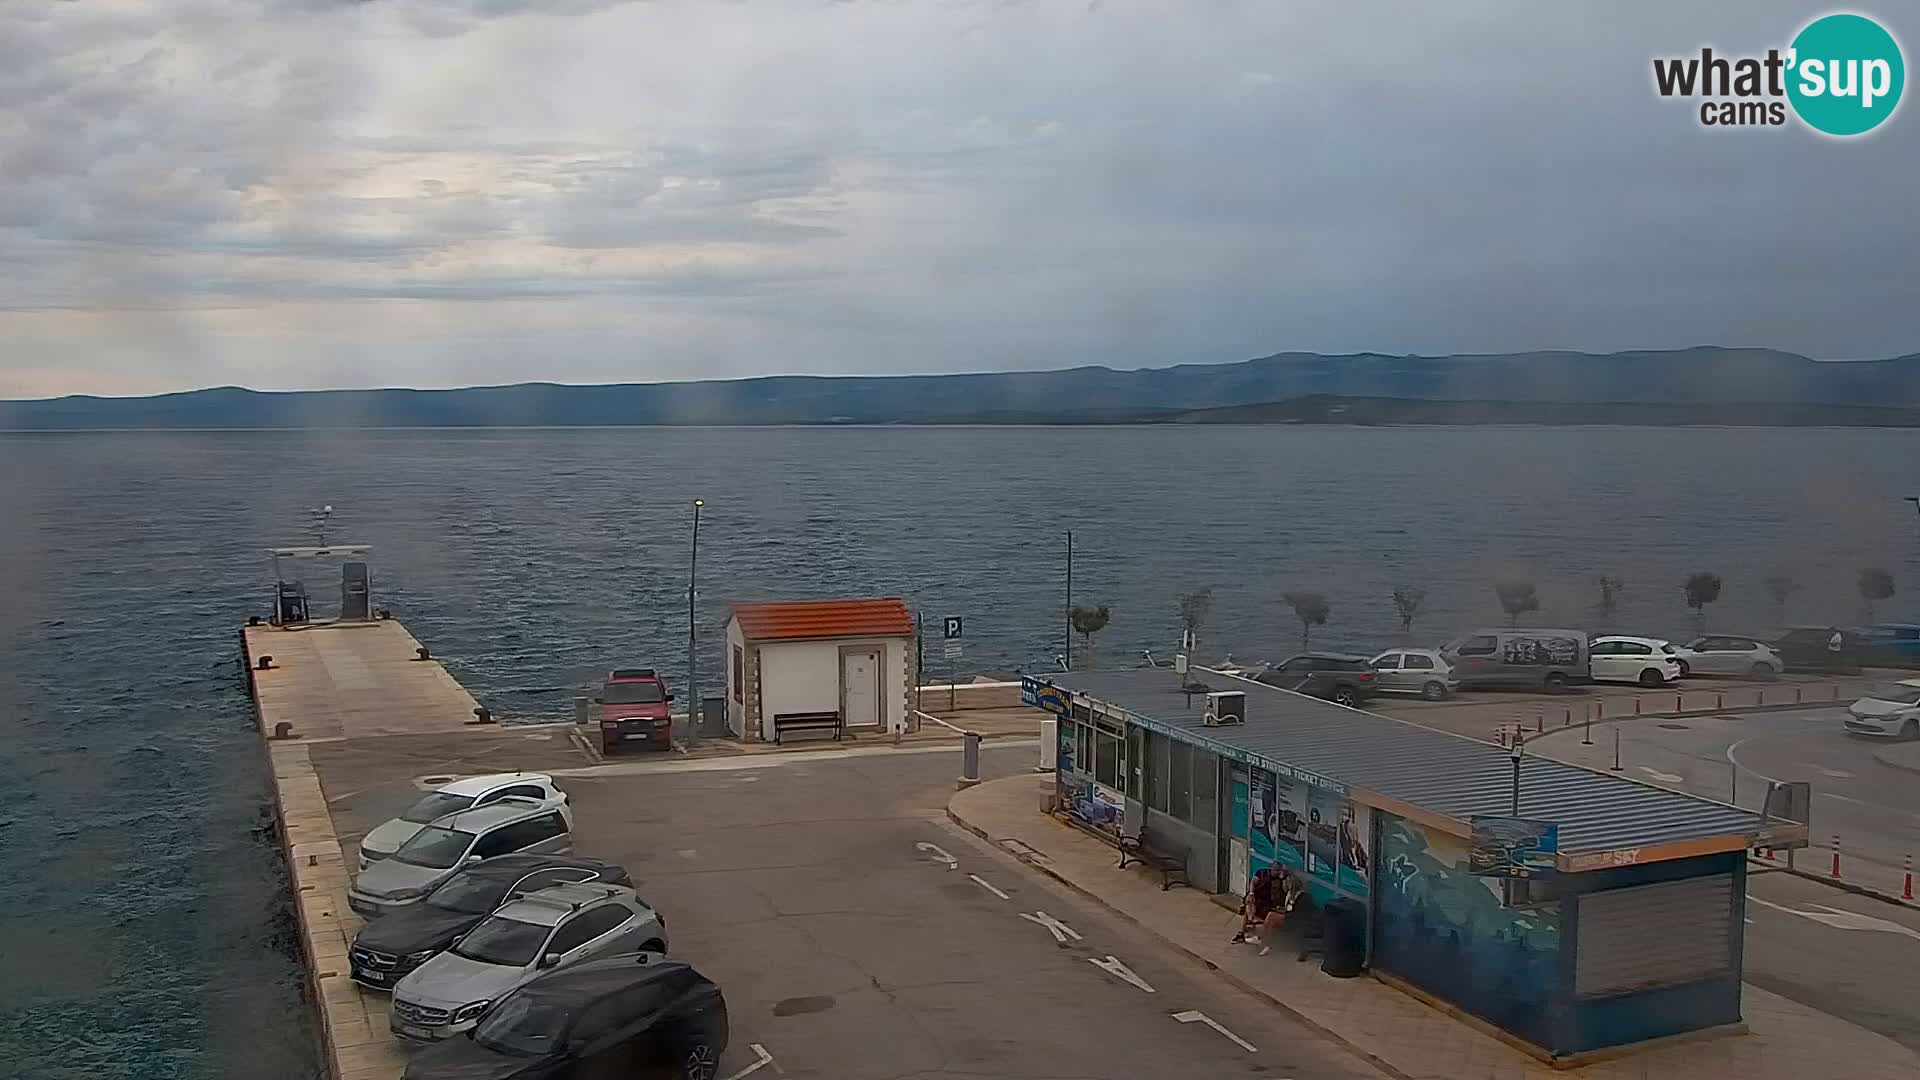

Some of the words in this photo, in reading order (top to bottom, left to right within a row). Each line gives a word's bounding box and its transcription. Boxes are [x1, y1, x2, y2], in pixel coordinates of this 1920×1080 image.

[948, 619, 959, 637] P
[1246, 753, 1260, 766] BUS
[1261, 759, 1292, 777] STATION
[1294, 769, 1319, 785] TICKET
